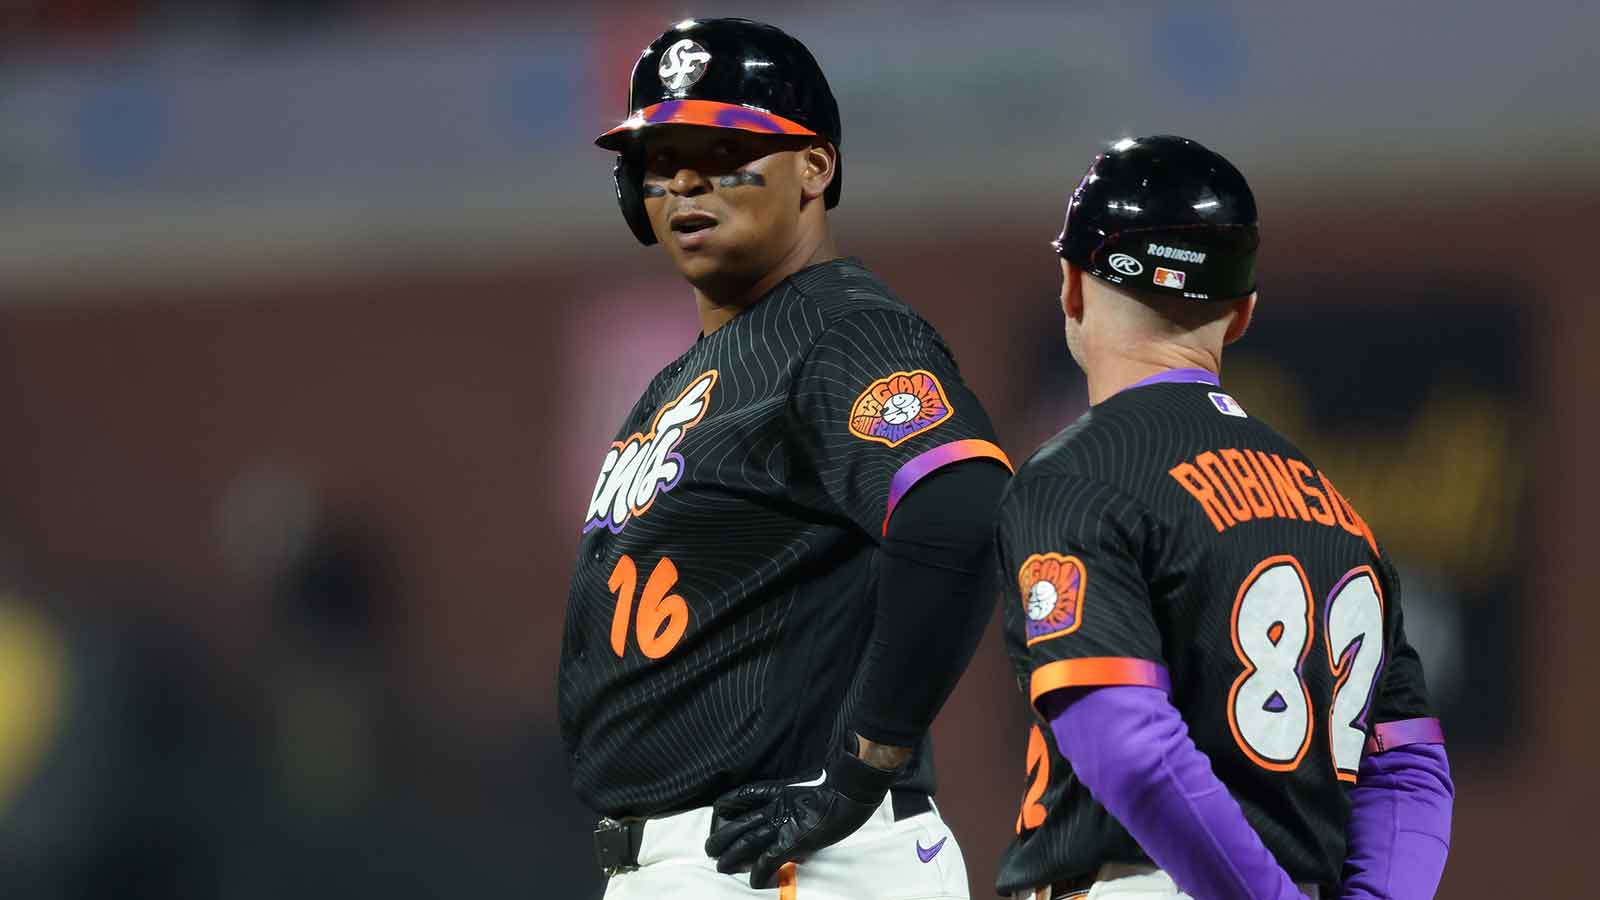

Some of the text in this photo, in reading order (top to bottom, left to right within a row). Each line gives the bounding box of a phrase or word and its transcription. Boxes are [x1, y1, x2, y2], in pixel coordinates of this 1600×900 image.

[659, 39, 712, 89] SF
[1147, 243, 1206, 265] ROBINSON
[1168, 448, 1381, 559] ROBINSO
[608, 554, 689, 659] 16
[1227, 554, 1387, 784] 82
